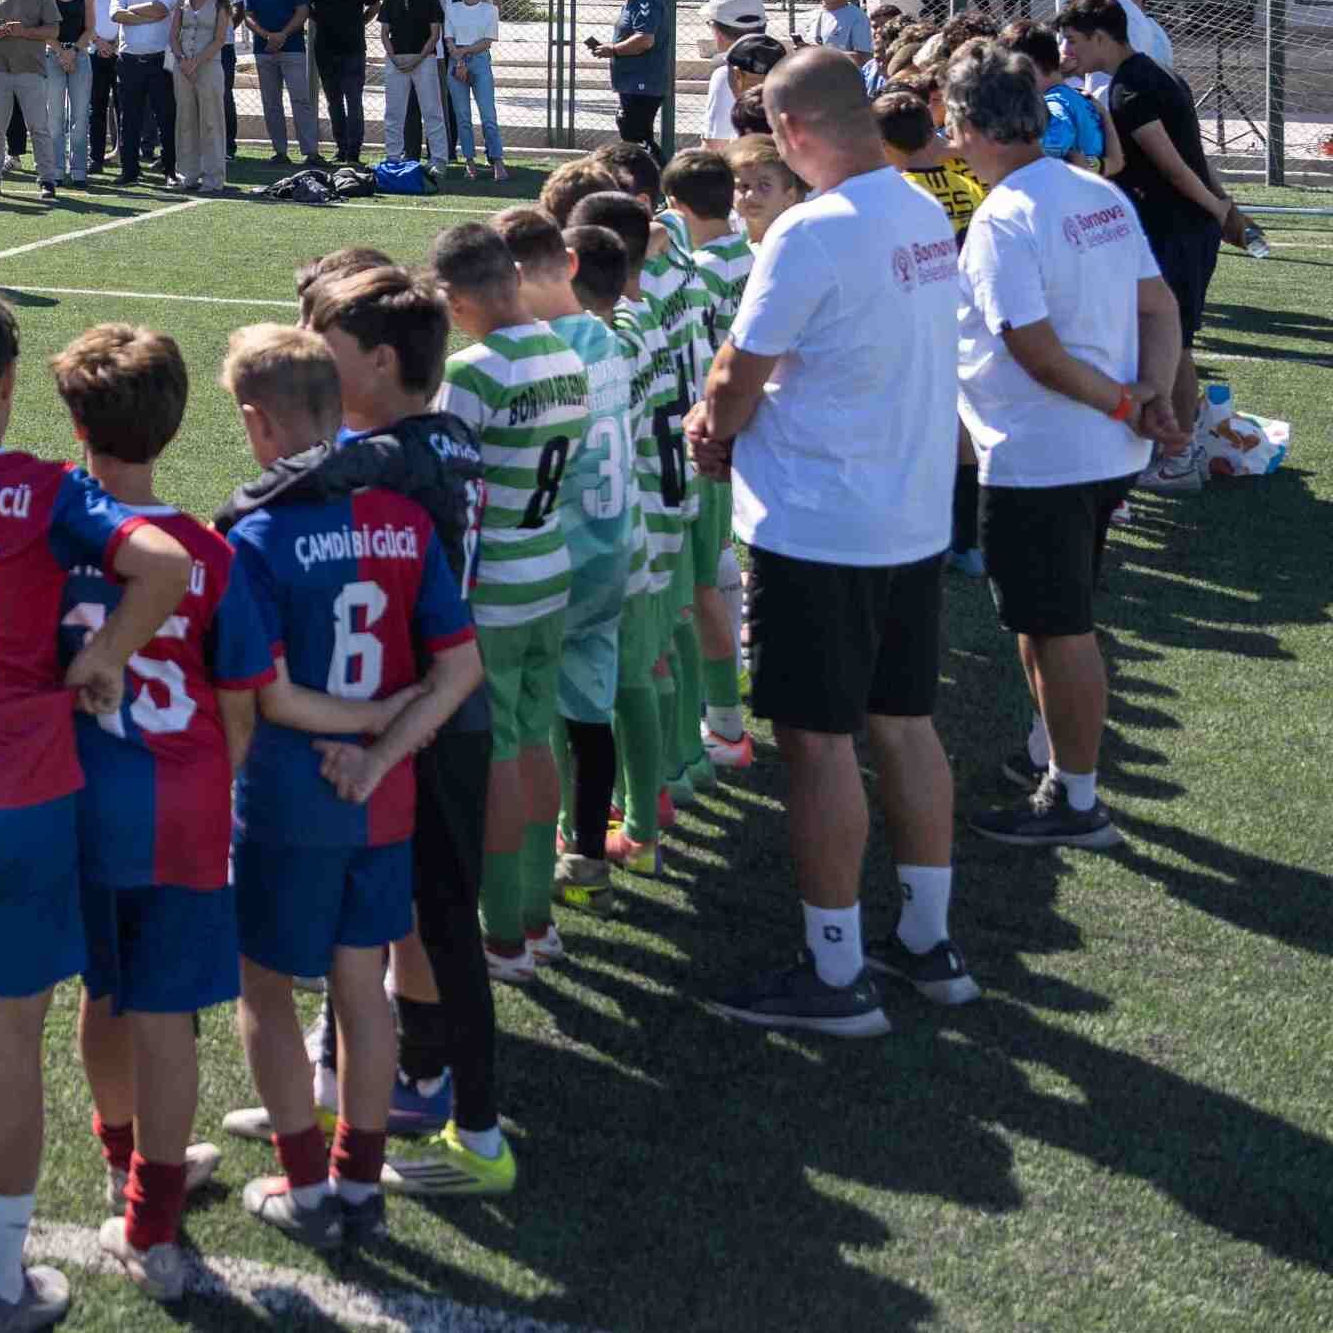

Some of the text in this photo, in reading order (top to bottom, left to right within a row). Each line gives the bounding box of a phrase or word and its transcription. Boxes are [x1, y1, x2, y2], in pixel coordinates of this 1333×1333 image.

[1078, 204, 1126, 232] Bornova
[582, 418, 624, 520] 3
[294, 523, 419, 572] ÇAMDİBİGÜCÜ
[327, 580, 388, 701] 6
